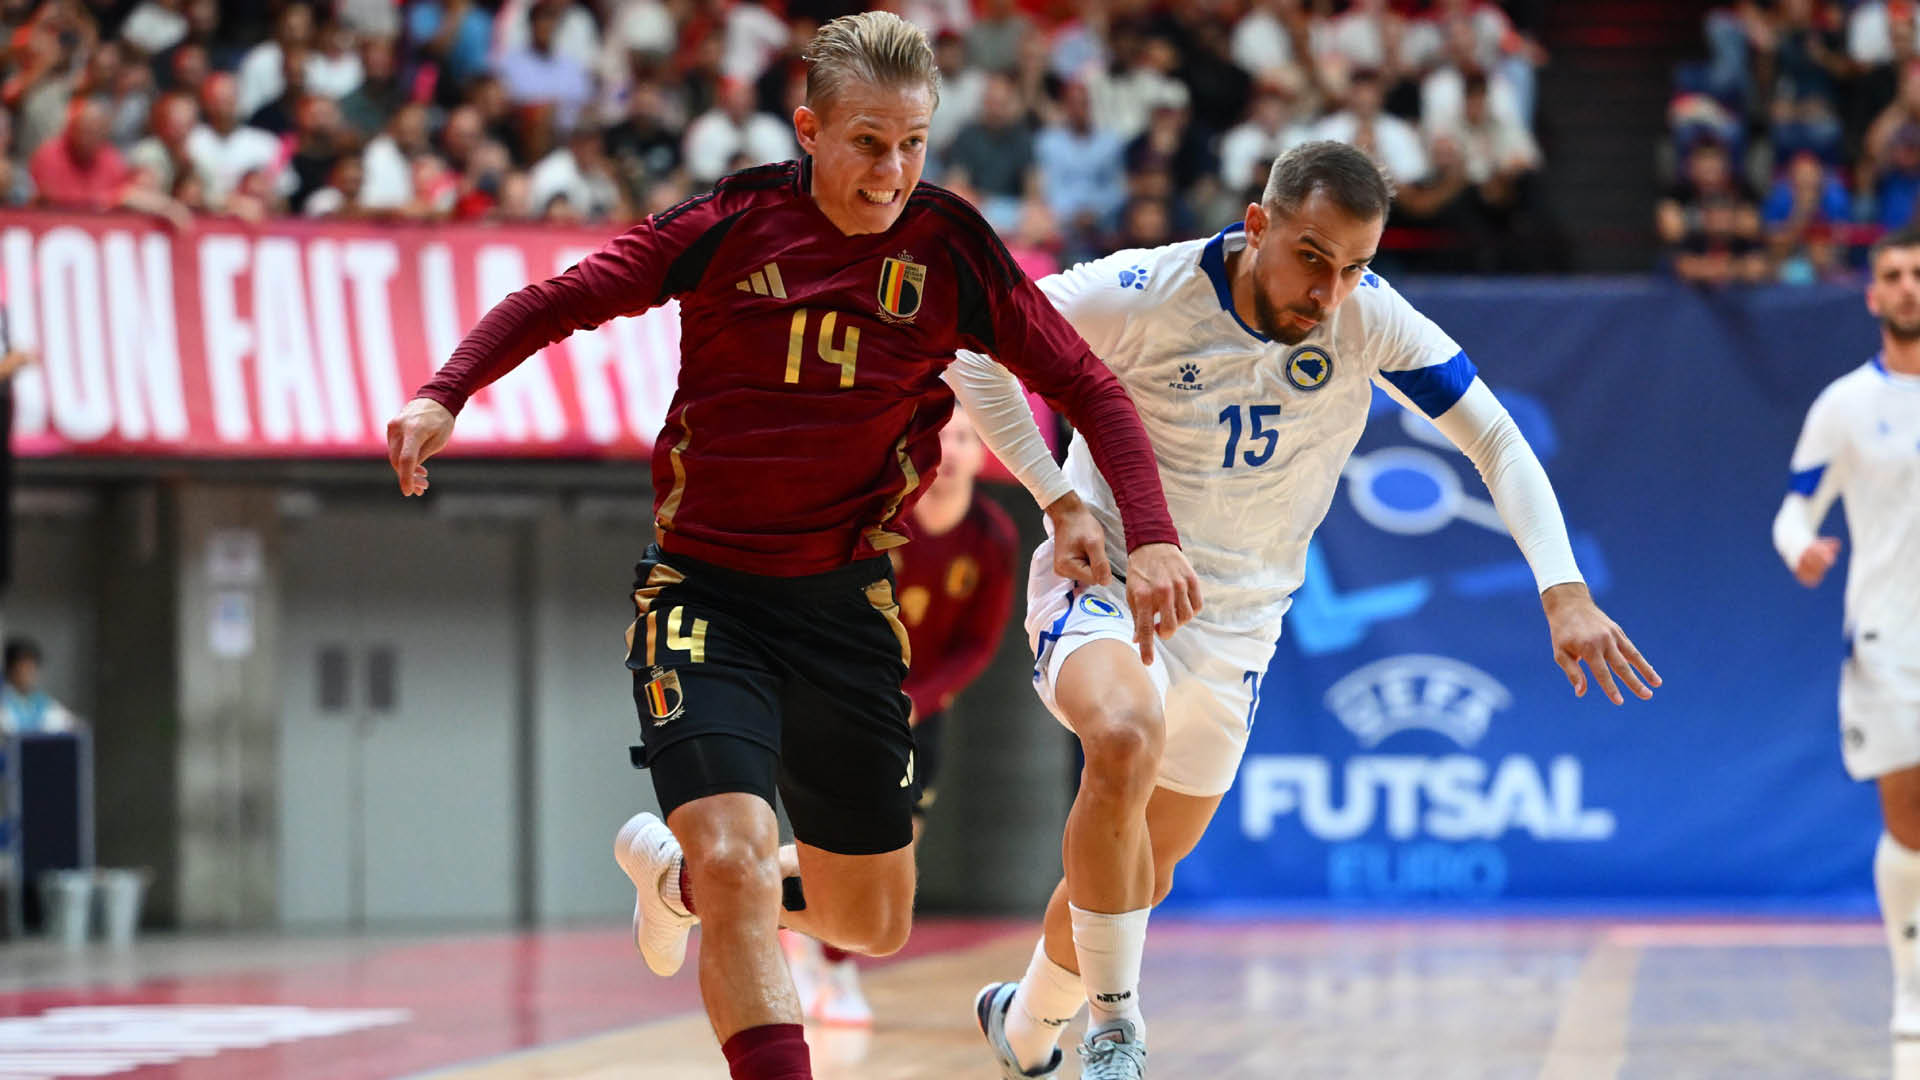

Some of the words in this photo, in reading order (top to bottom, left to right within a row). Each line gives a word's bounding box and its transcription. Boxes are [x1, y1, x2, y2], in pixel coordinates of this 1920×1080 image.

[198, 233, 404, 445] FAIT
[784, 309, 860, 388] 14
[1168, 382, 1204, 391] KELME
[1219, 404, 1281, 468] 15
[645, 605, 708, 667] 14
[1324, 653, 1512, 748] UEFA
[1241, 754, 1617, 841] FUTSAL
[1328, 843, 1508, 898] EURO
